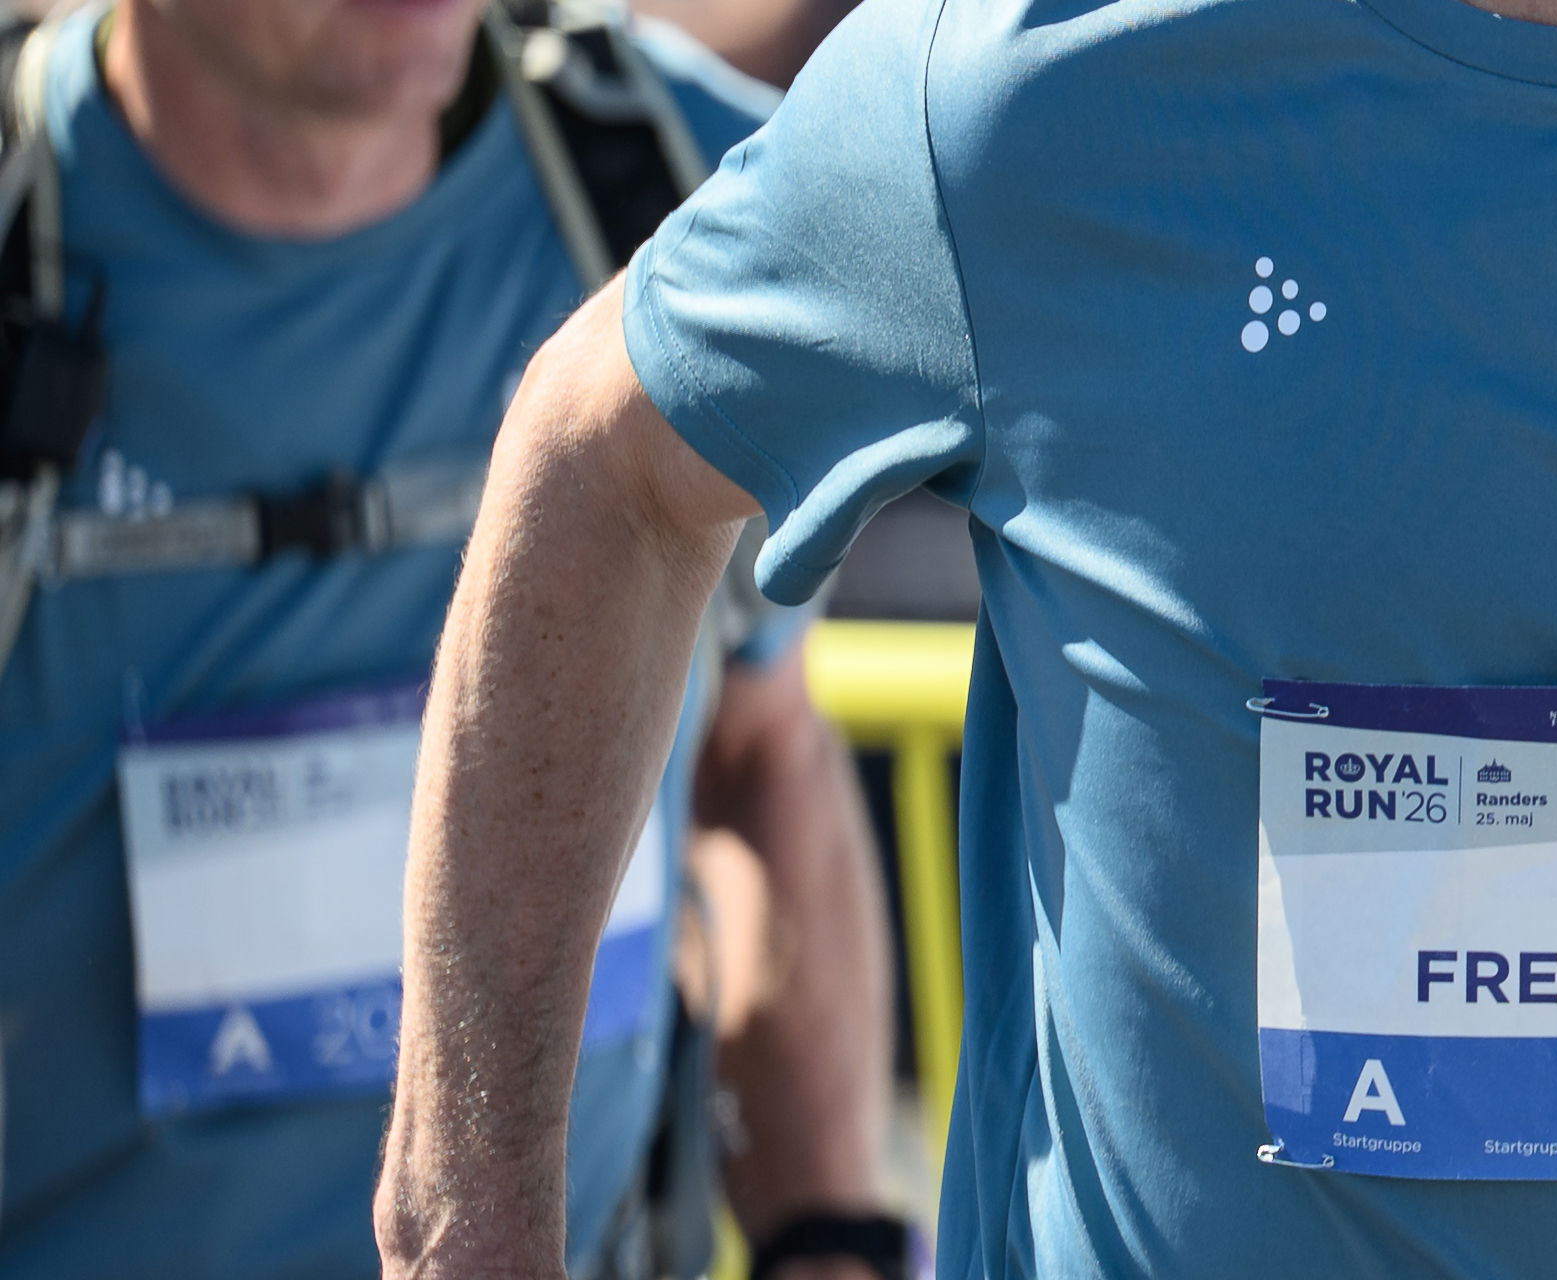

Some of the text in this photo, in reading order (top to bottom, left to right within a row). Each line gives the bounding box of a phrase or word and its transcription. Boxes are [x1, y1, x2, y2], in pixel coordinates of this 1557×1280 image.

[1304, 751, 1449, 786] ROYAL
[1305, 788, 1397, 821] RUN
[1476, 792, 1548, 807] Randers
[1476, 812, 1534, 827] 25. maj
[1342, 1059, 1406, 1126] A
[1332, 1132, 1422, 1153] Startgruppe
